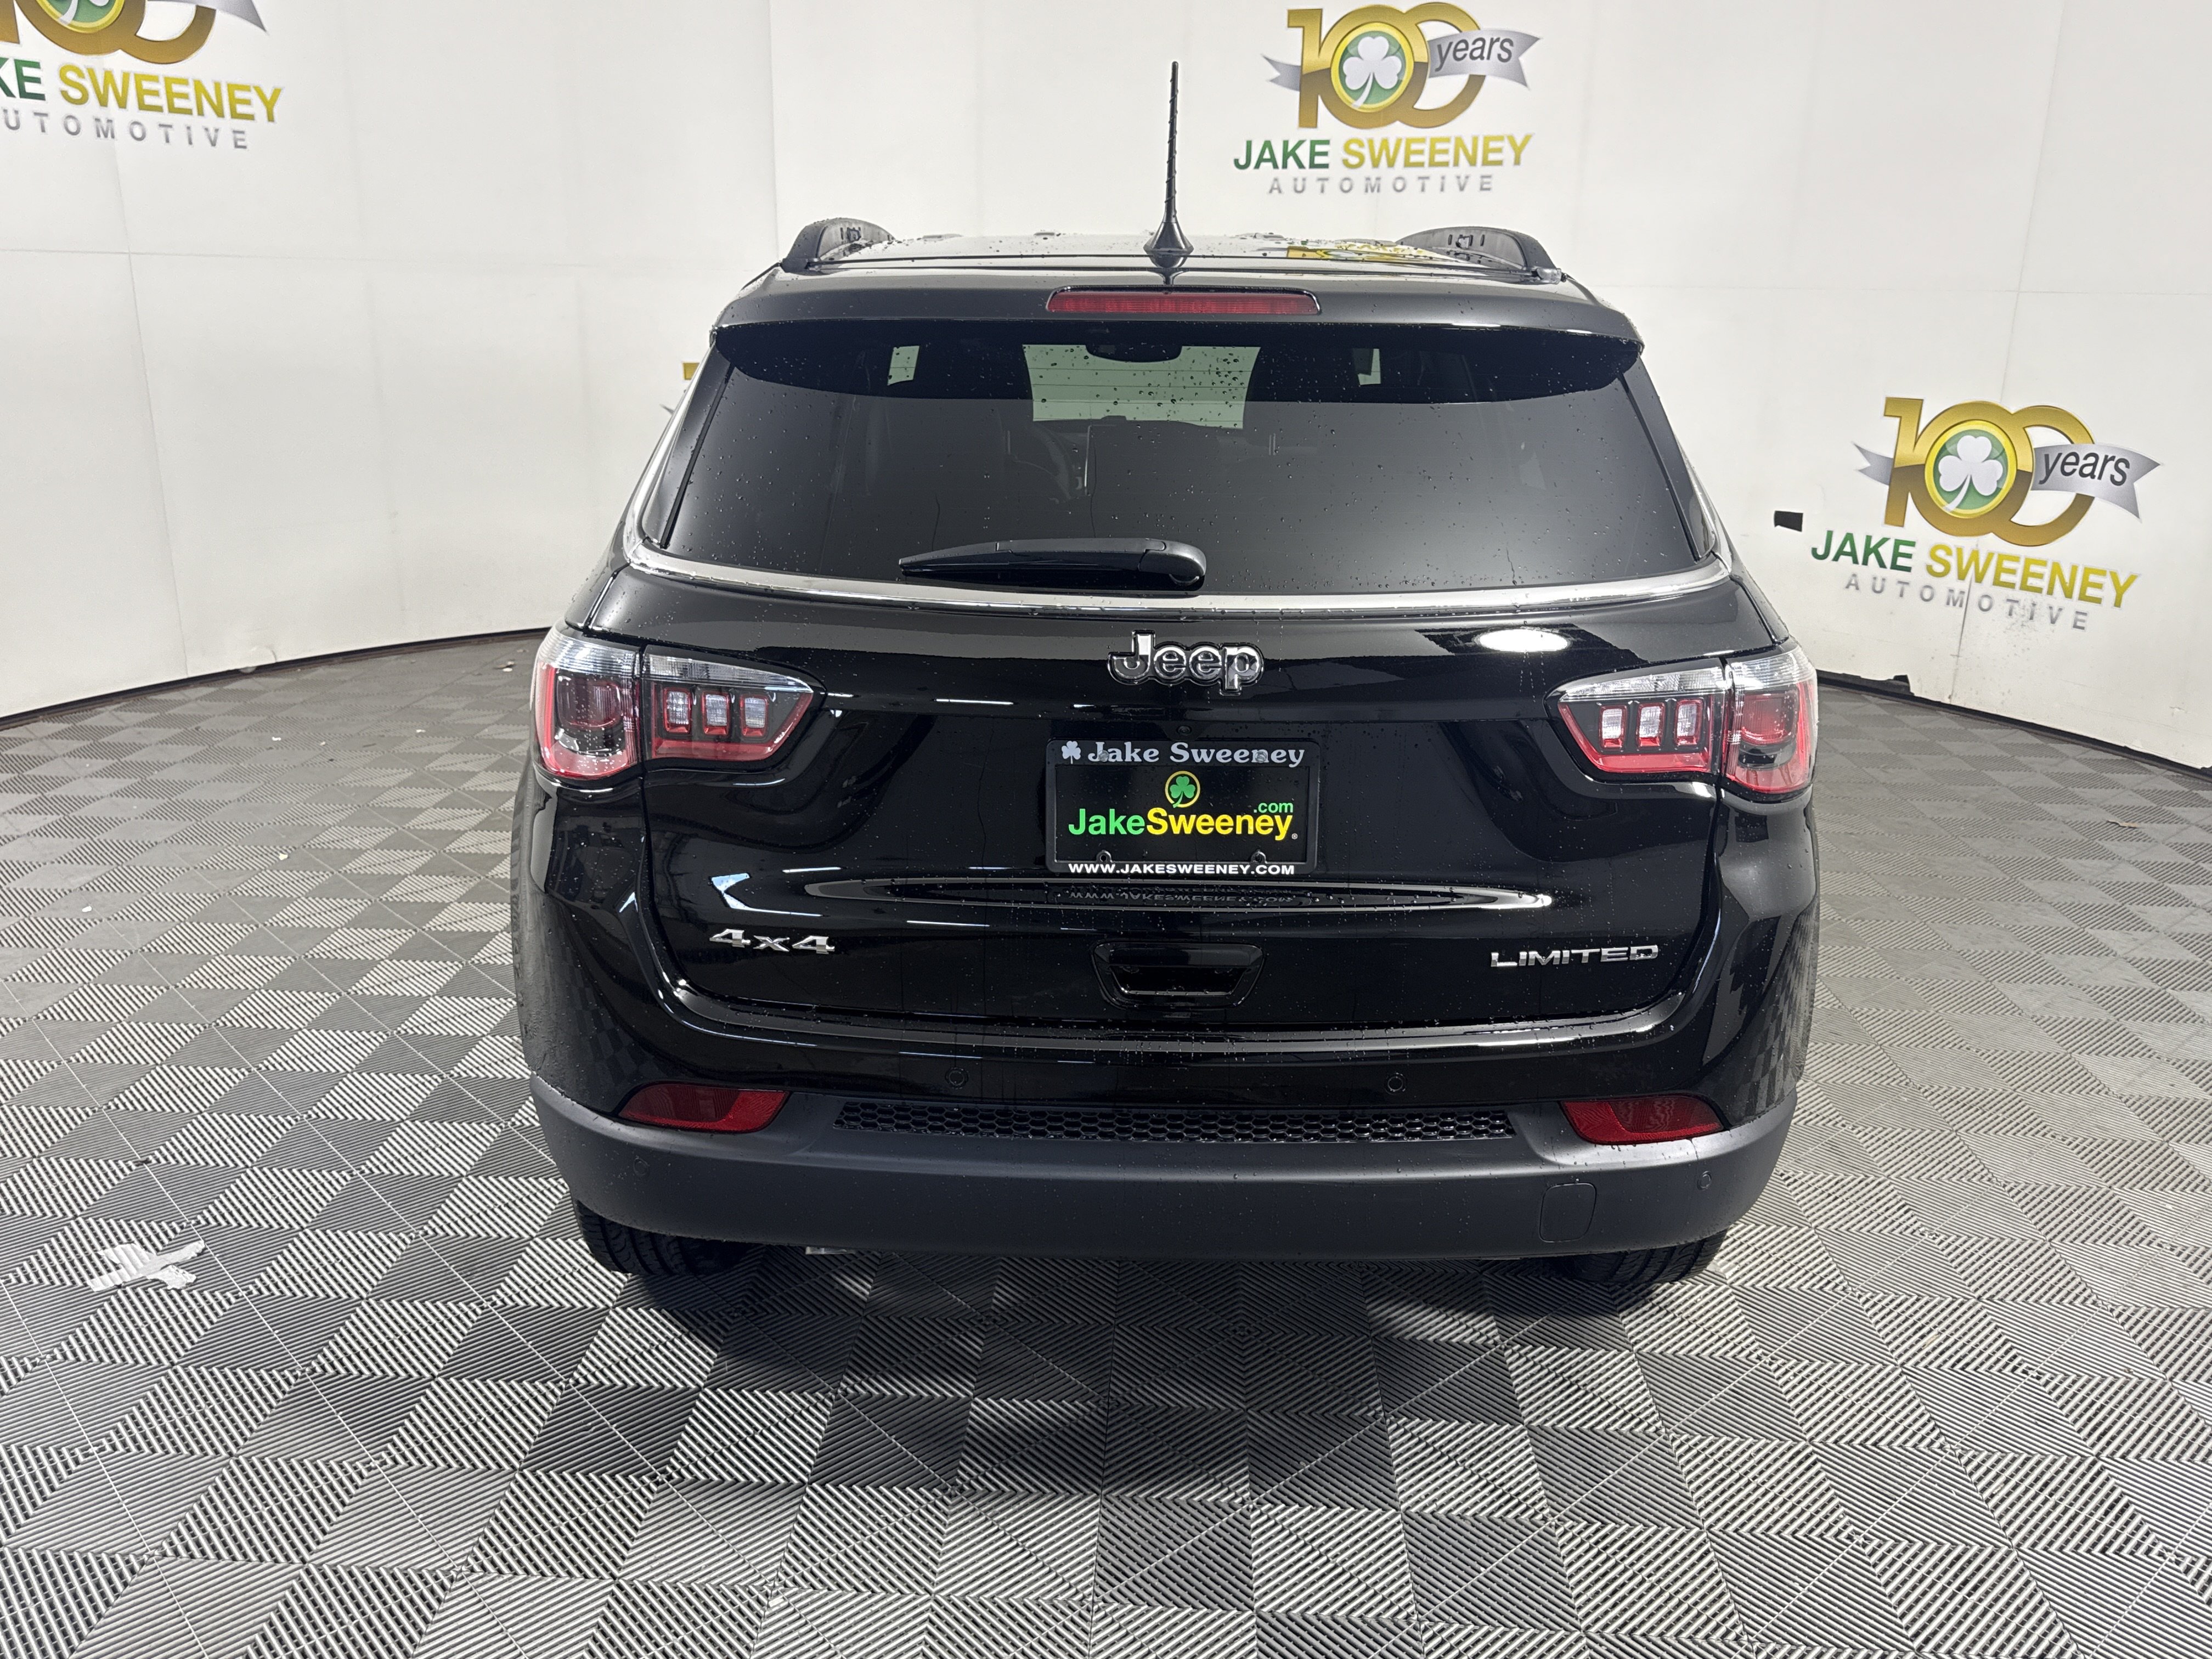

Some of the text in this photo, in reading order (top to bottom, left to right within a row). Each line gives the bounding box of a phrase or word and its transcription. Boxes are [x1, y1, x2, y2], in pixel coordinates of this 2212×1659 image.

[1435, 36, 1514, 71] years
[59, 64, 283, 122] SWEENEY
[2, 108, 248, 150] UTOMOTIVE
[1233, 133, 1533, 170] JAKE SWEENEY
[1268, 174, 1494, 194] AUTOMOTIVE
[2038, 451, 2131, 486] years
[1811, 530, 2138, 608] JAKE SWEENEY
[1845, 572, 2088, 631] AUTOMOTIVE
[1109, 631, 1263, 693] Jeep
[1087, 741, 1305, 768] Jake Sweeney
[1068, 863, 1295, 876] WWW.JAKESWEENEY.COM
[709, 928, 836, 955] 4x4
[1490, 944, 1659, 967] LIMITED
